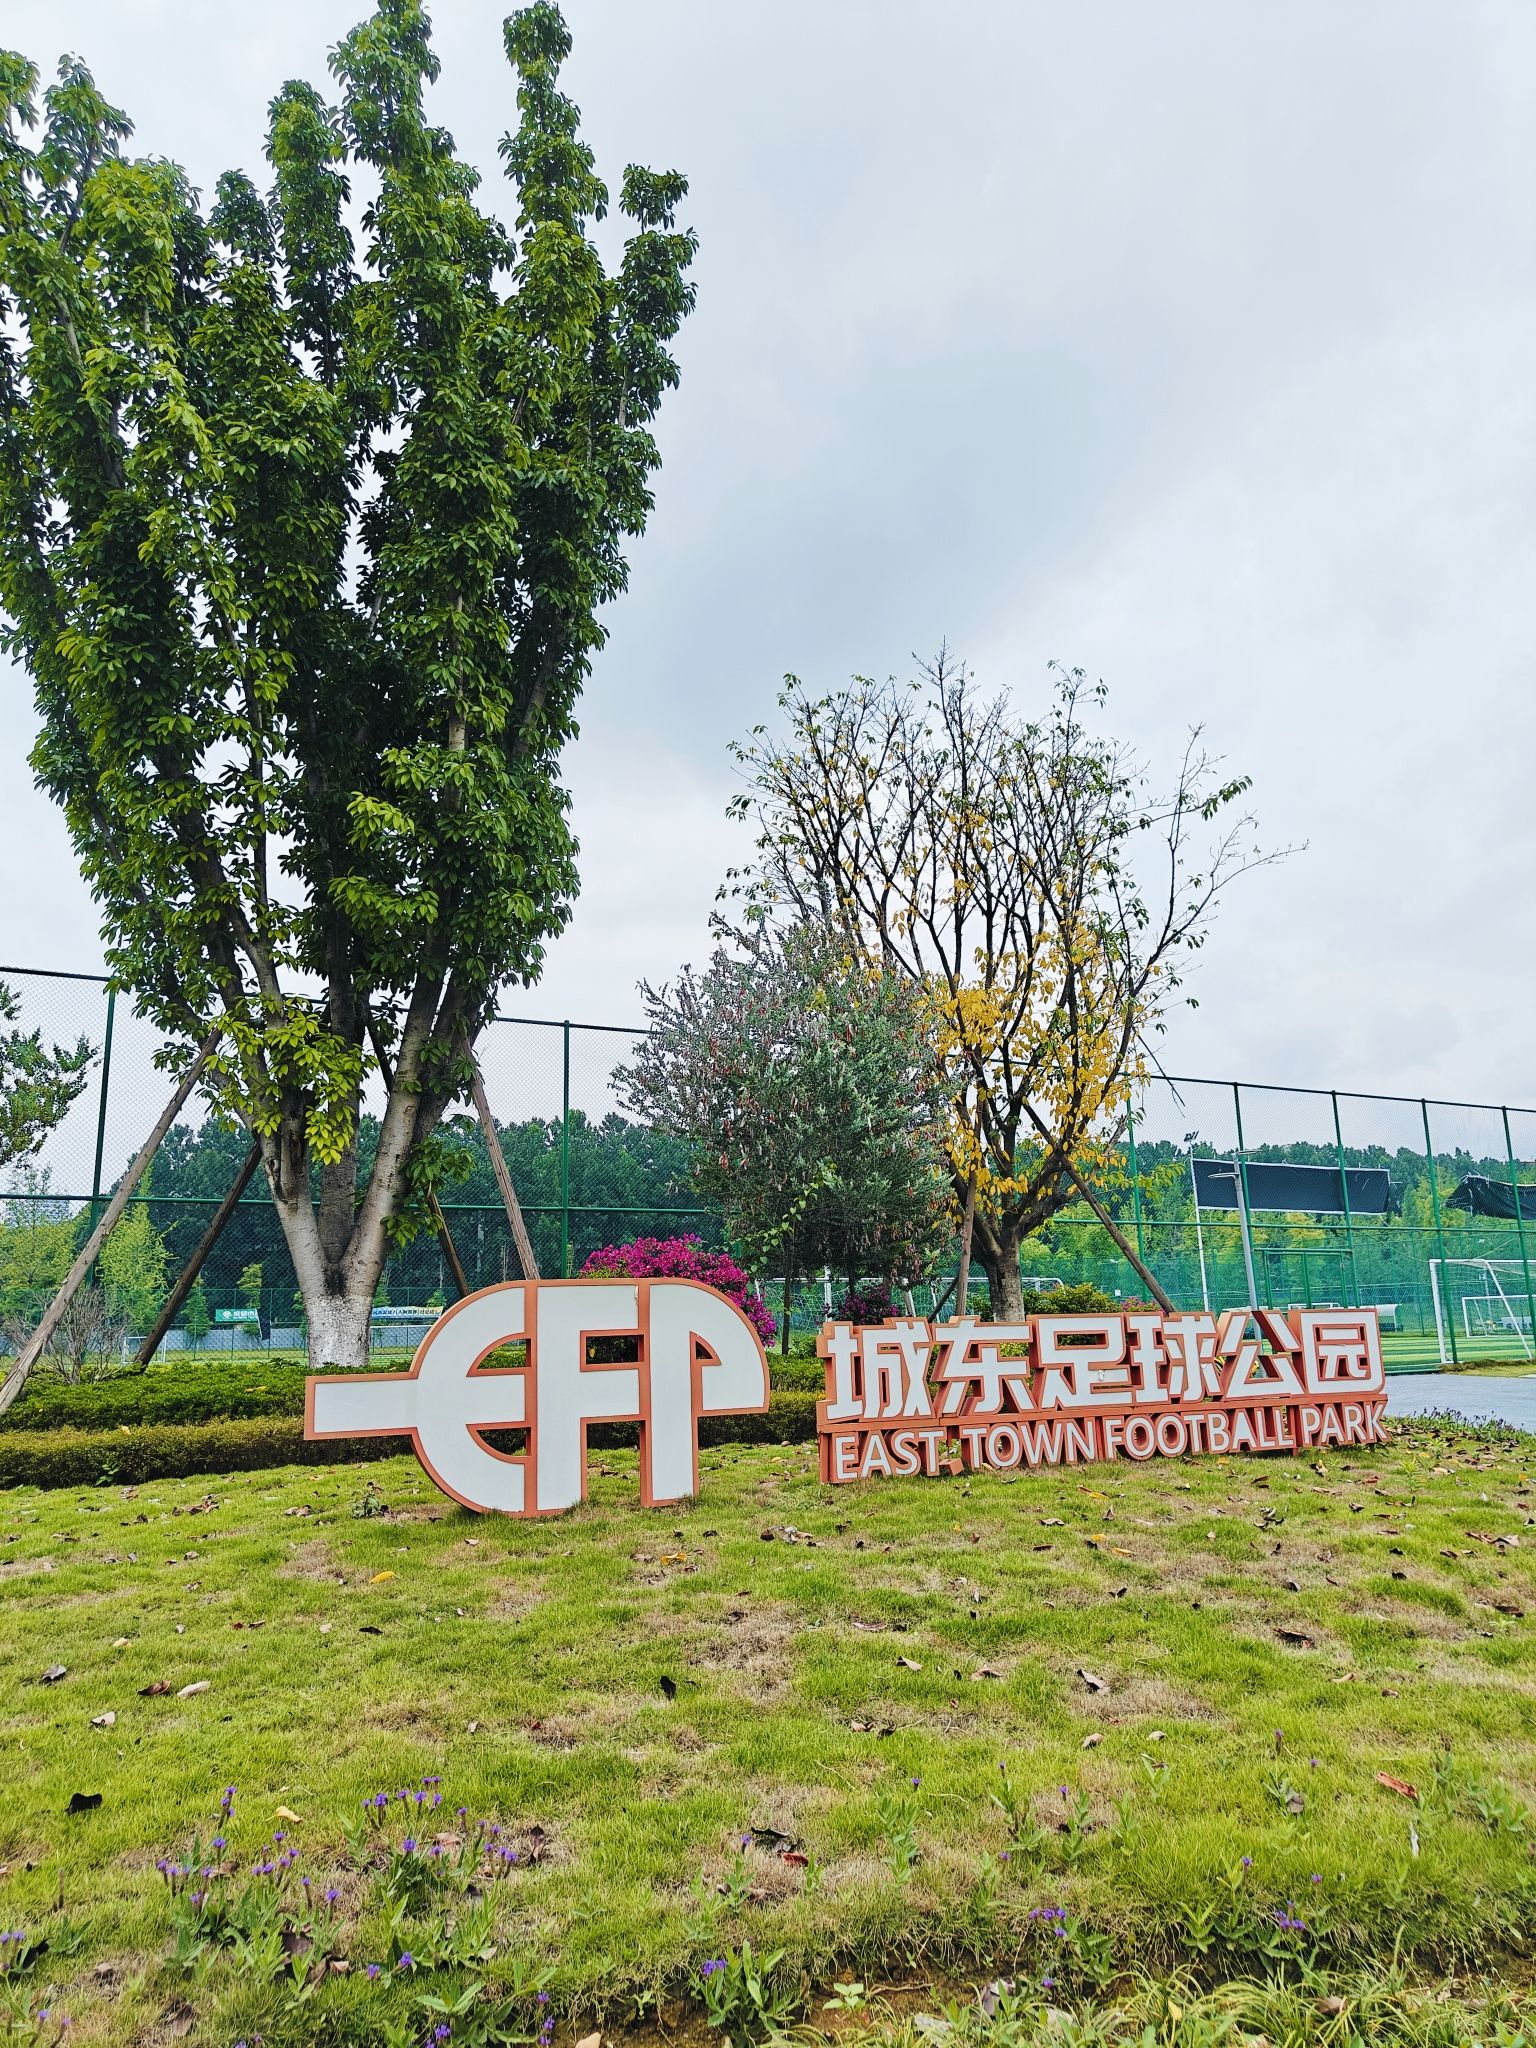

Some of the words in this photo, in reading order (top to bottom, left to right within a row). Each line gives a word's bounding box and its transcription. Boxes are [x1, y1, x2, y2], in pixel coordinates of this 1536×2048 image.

[824, 1309, 1385, 1420] 城东足球公园
[834, 1429, 946, 1481] EAST
[961, 1419, 1097, 1470] TOWN
[1103, 1406, 1295, 1460] FOOTBALL
[1301, 1403, 1389, 1445] PARK
